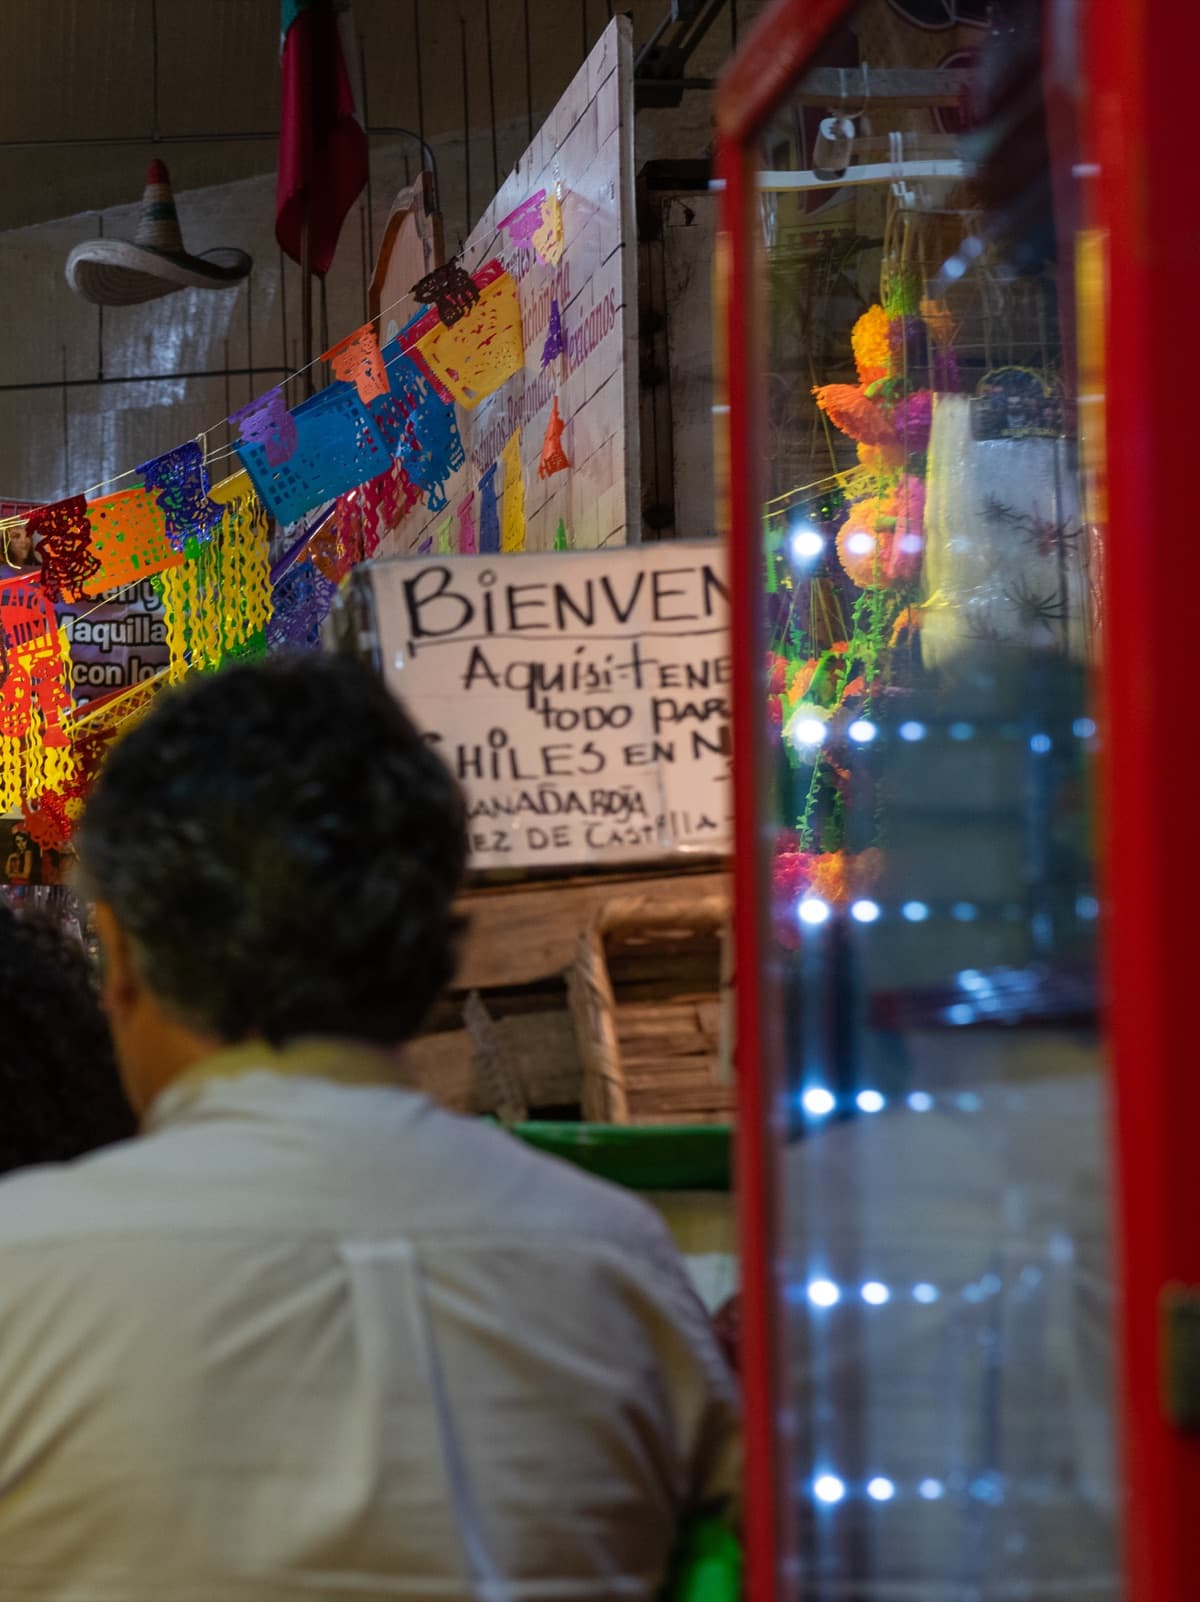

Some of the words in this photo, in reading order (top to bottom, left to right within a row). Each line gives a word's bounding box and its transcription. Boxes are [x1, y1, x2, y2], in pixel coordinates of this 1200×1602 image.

[72, 663, 122, 685] con
[463, 829, 512, 856] EZ
[526, 825, 572, 851] DE
